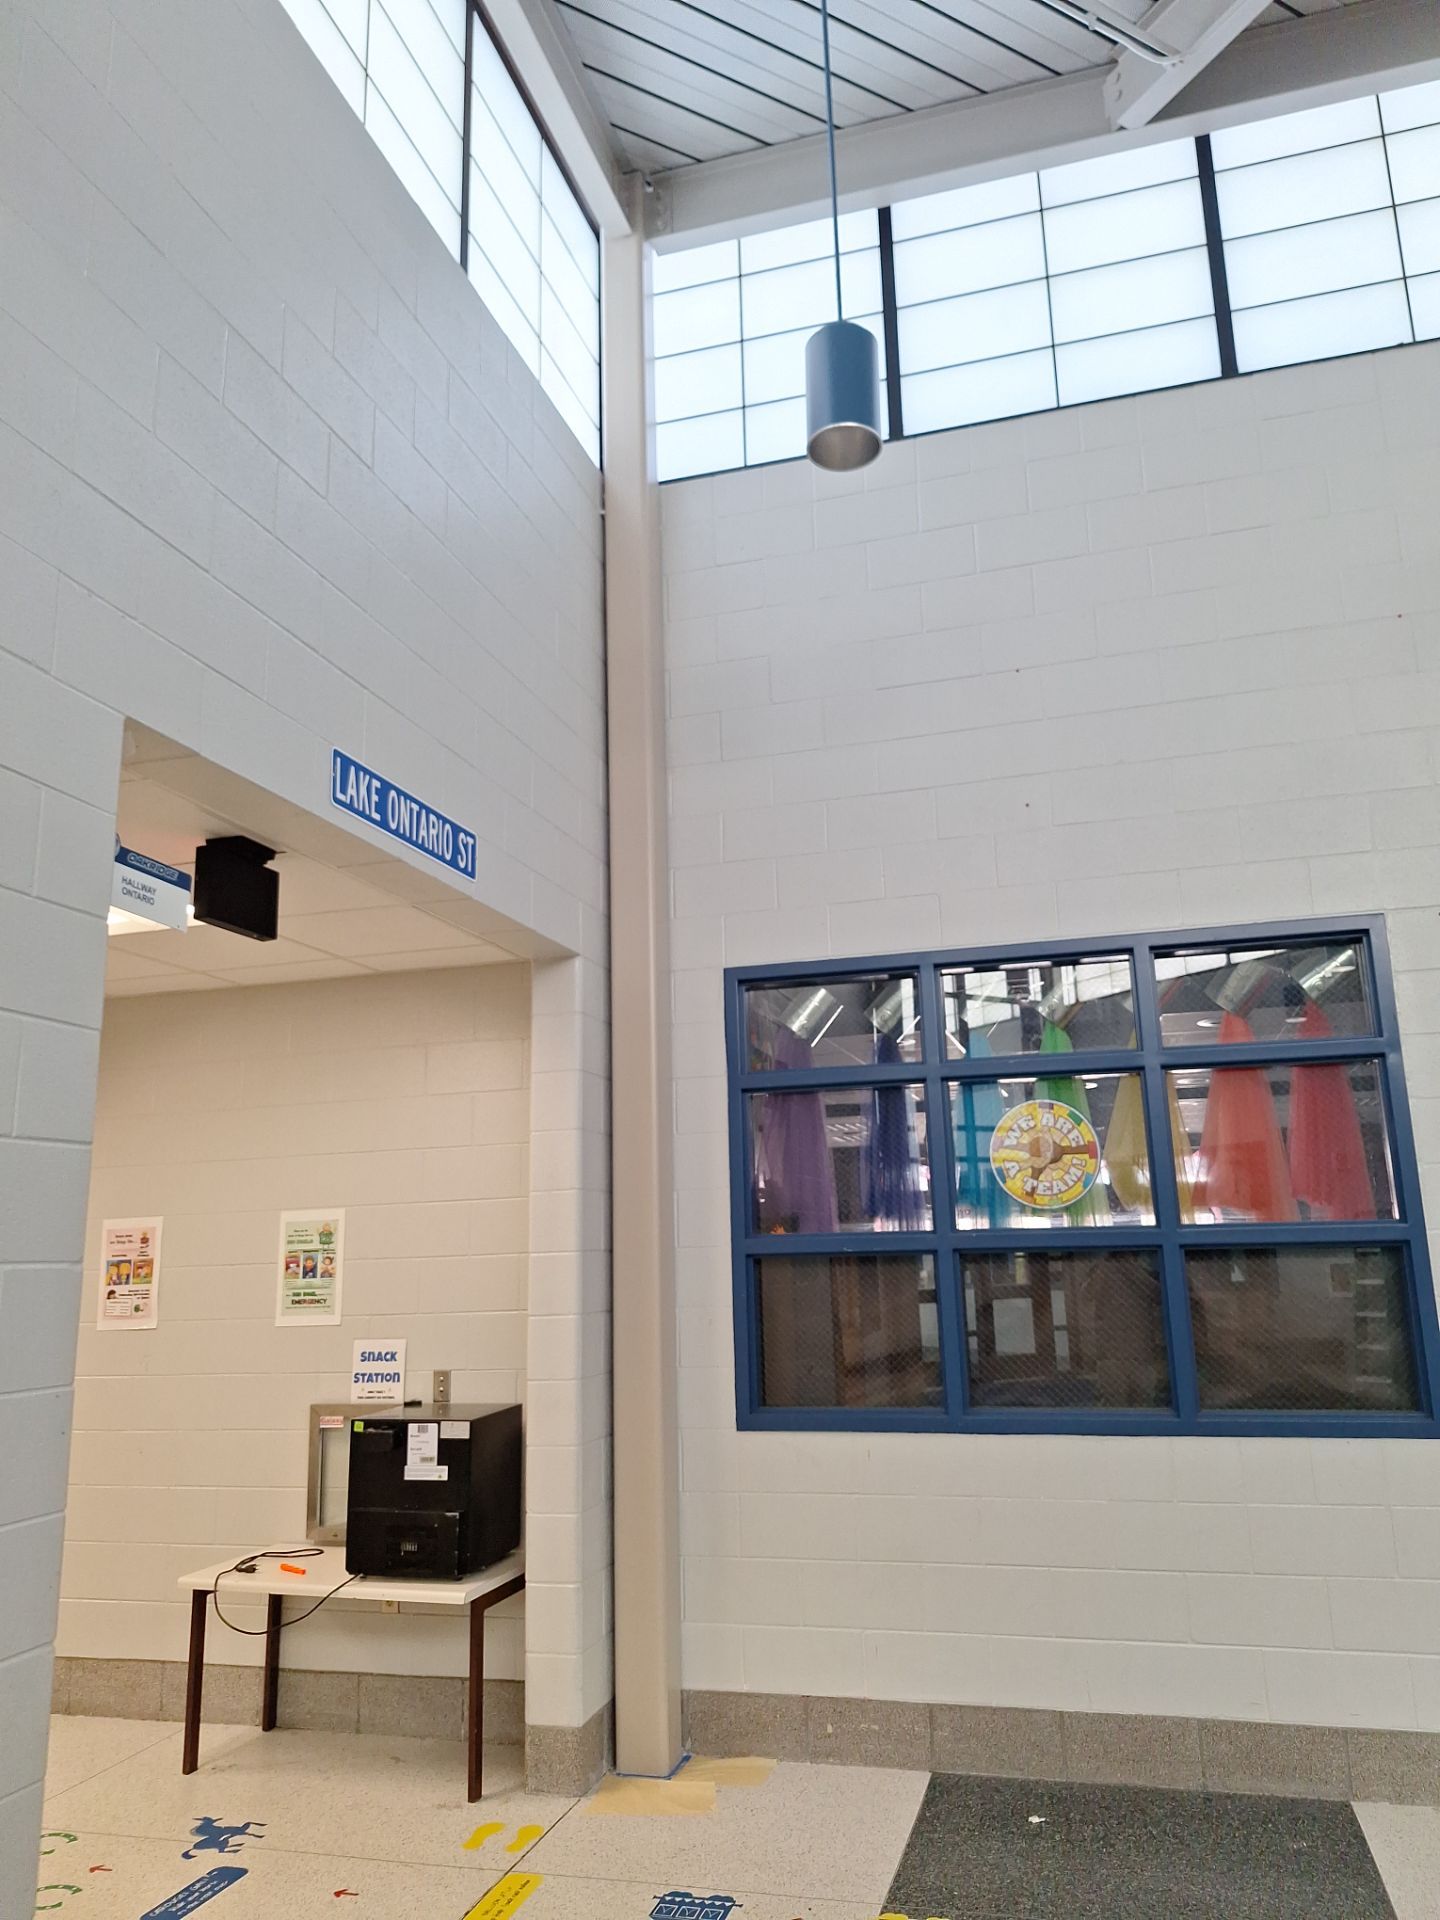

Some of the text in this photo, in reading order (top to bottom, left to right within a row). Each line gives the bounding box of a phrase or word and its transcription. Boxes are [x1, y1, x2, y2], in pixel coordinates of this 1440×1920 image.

[335, 757, 474, 873] LAKE ONTARIO ST
[127, 852, 179, 880] OAKRIDGE
[121, 876, 157, 895] HALLWAY
[121, 887, 155, 906] ONTARIO
[1003, 1111, 1085, 1147] WE ARE
[1003, 1157, 1085, 1195] A TEAM!
[360, 1351, 397, 1362] SNACK
[353, 1372, 400, 1383] STATION
